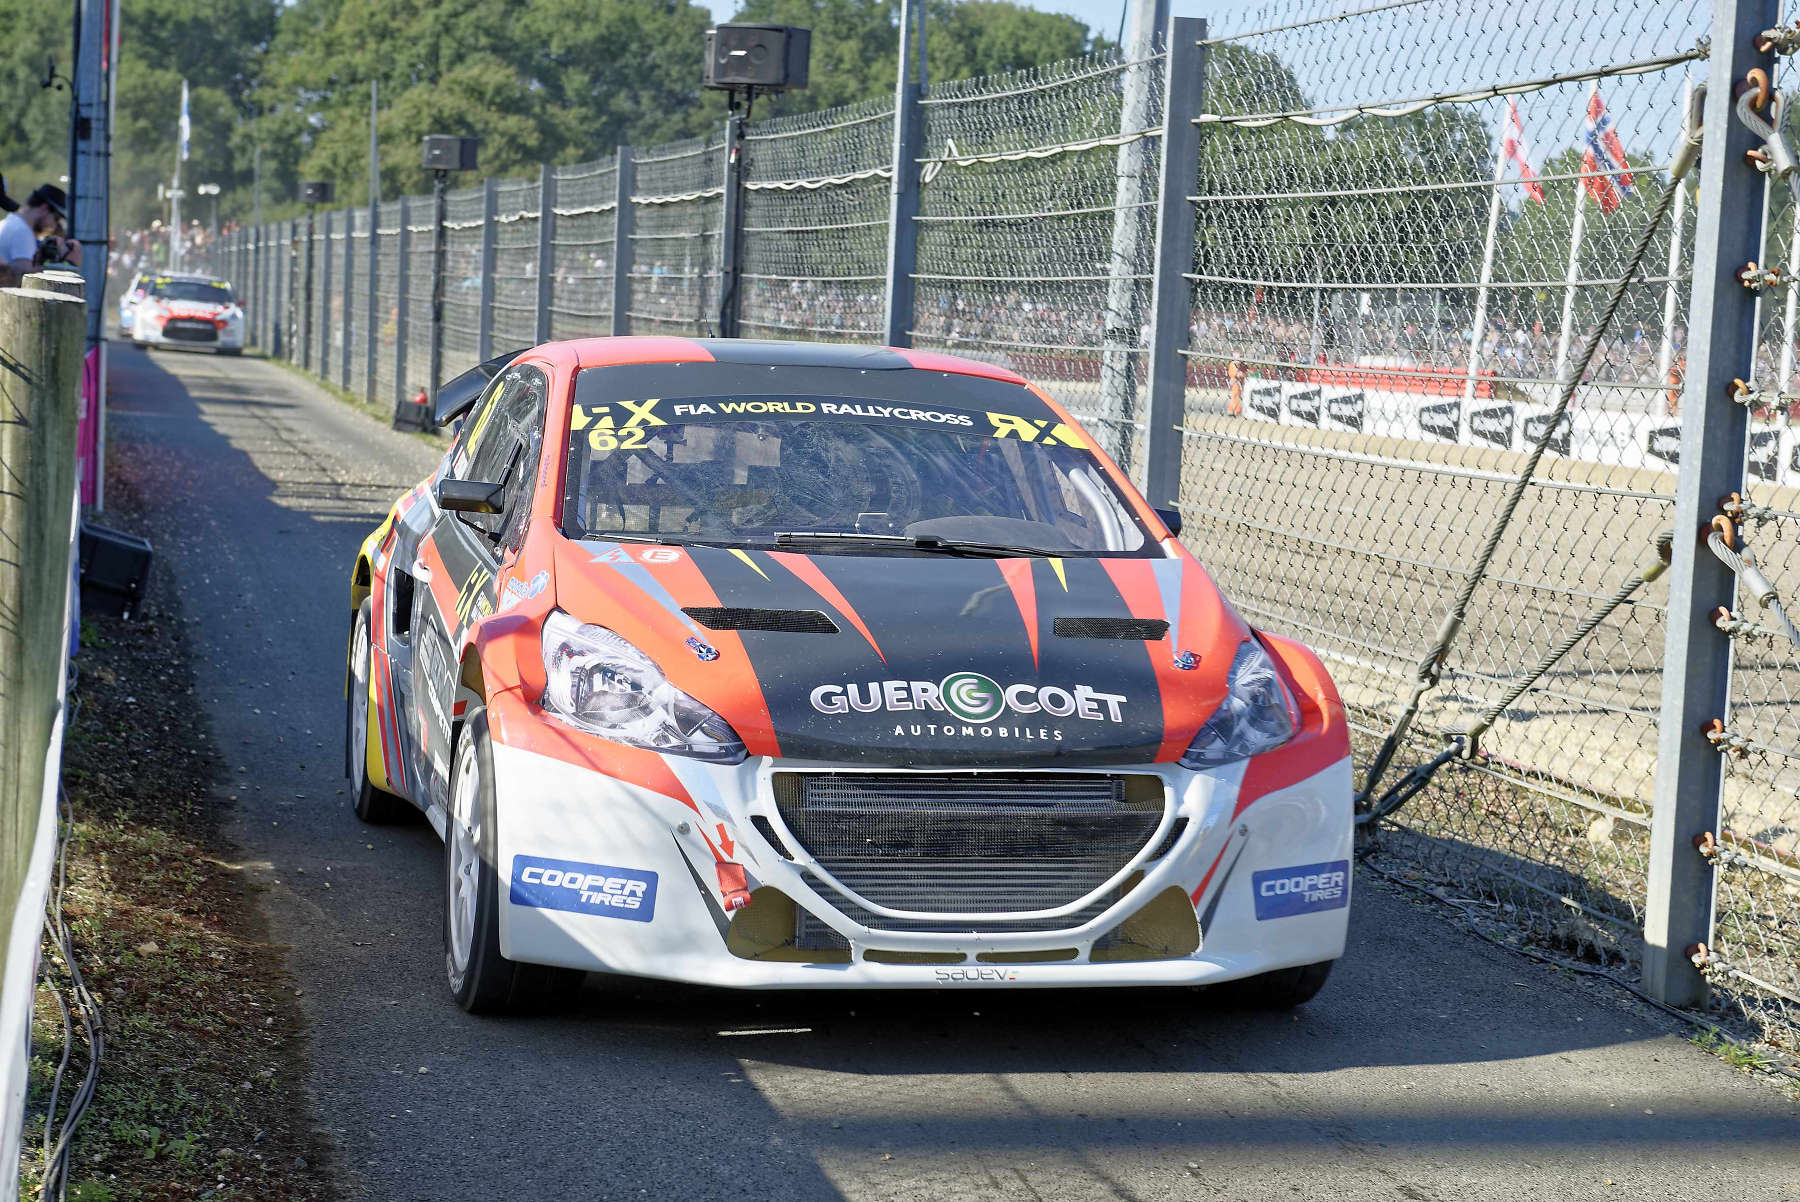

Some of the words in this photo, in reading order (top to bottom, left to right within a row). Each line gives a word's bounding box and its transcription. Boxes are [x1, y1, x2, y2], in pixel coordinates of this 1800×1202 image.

[673, 403, 717, 416] FIA
[718, 401, 817, 415] WORLD
[821, 403, 974, 427] RALLYCROSS
[588, 428, 648, 451] 62
[894, 725, 1063, 741] AUTOMOBILES
[521, 866, 648, 897] COOPER
[1260, 871, 1345, 897] COOPER
[579, 890, 642, 910] TIRES
[1302, 887, 1343, 904] TIRES
